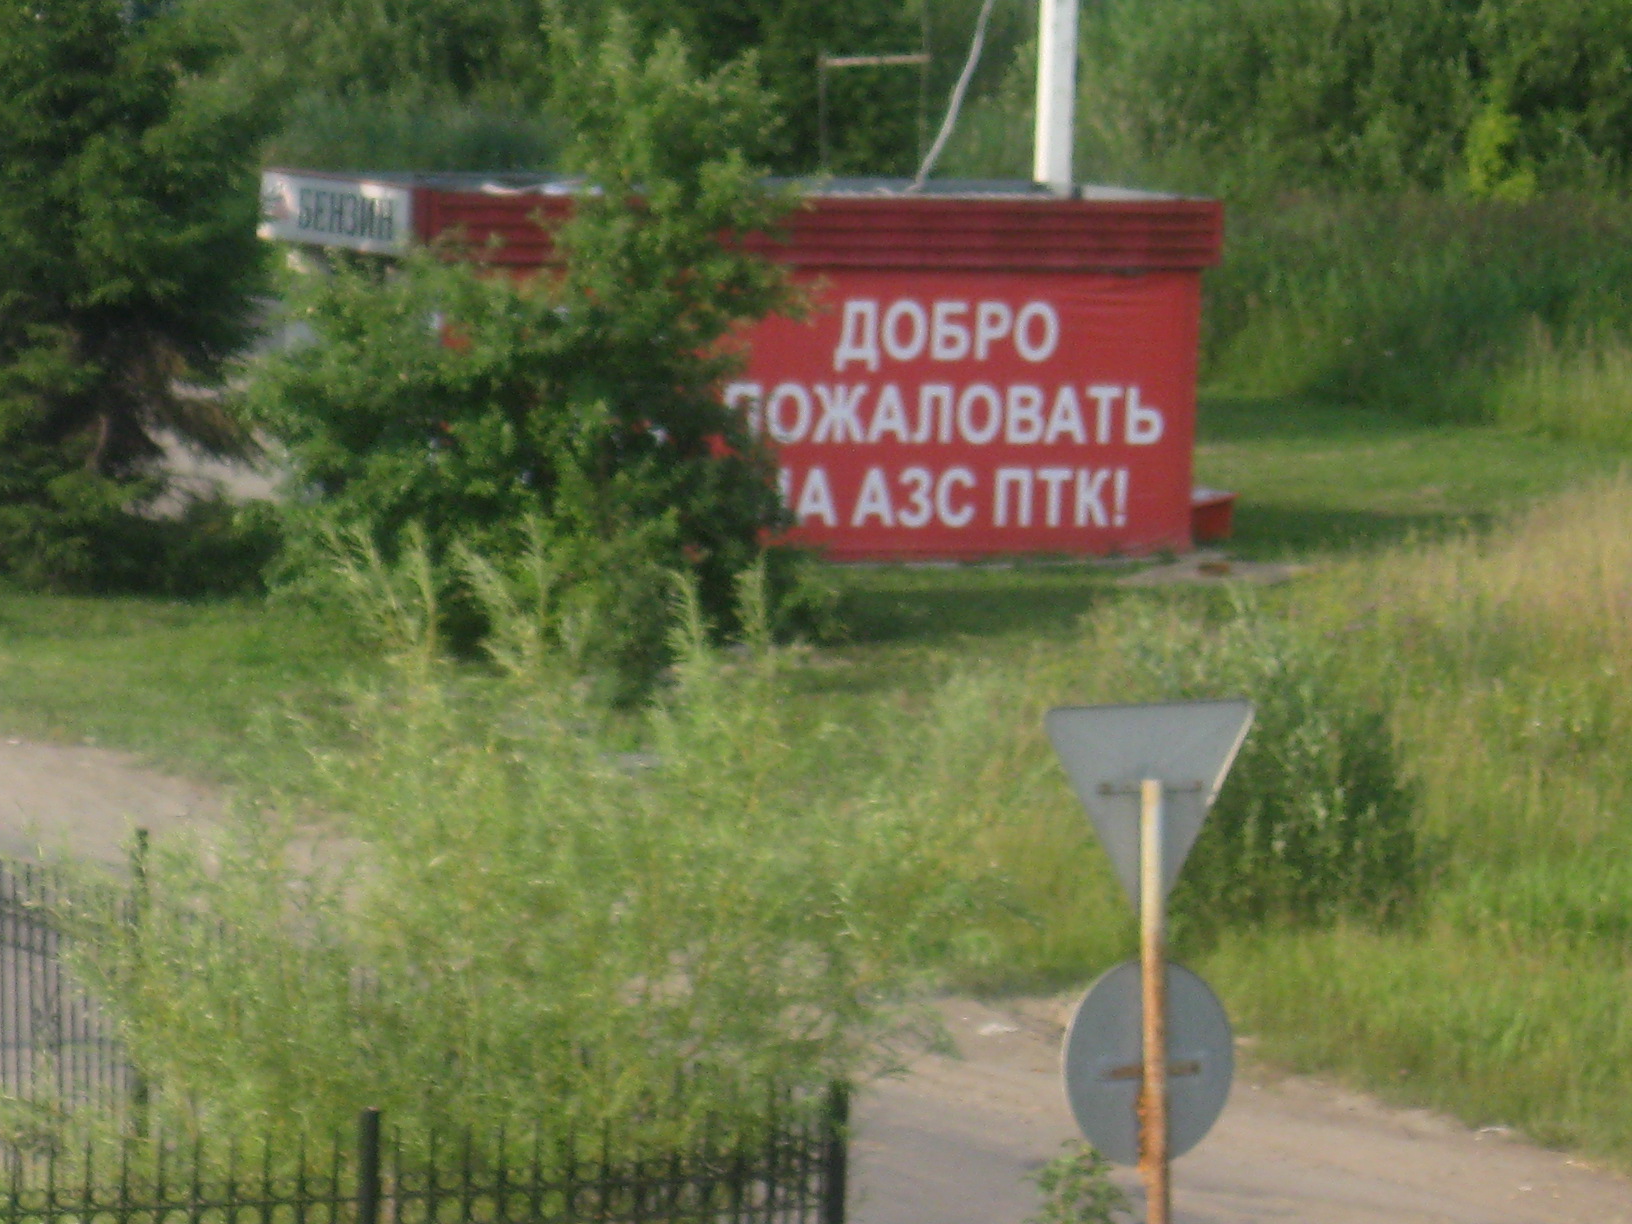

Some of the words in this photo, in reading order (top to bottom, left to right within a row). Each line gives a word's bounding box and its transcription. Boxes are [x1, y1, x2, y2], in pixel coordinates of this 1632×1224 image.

[299, 187, 394, 241] БЕНЗИН
[833, 299, 1060, 373] ДОБРО
[850, 467, 975, 529] АЗС
[994, 467, 1130, 528] ПТК!
